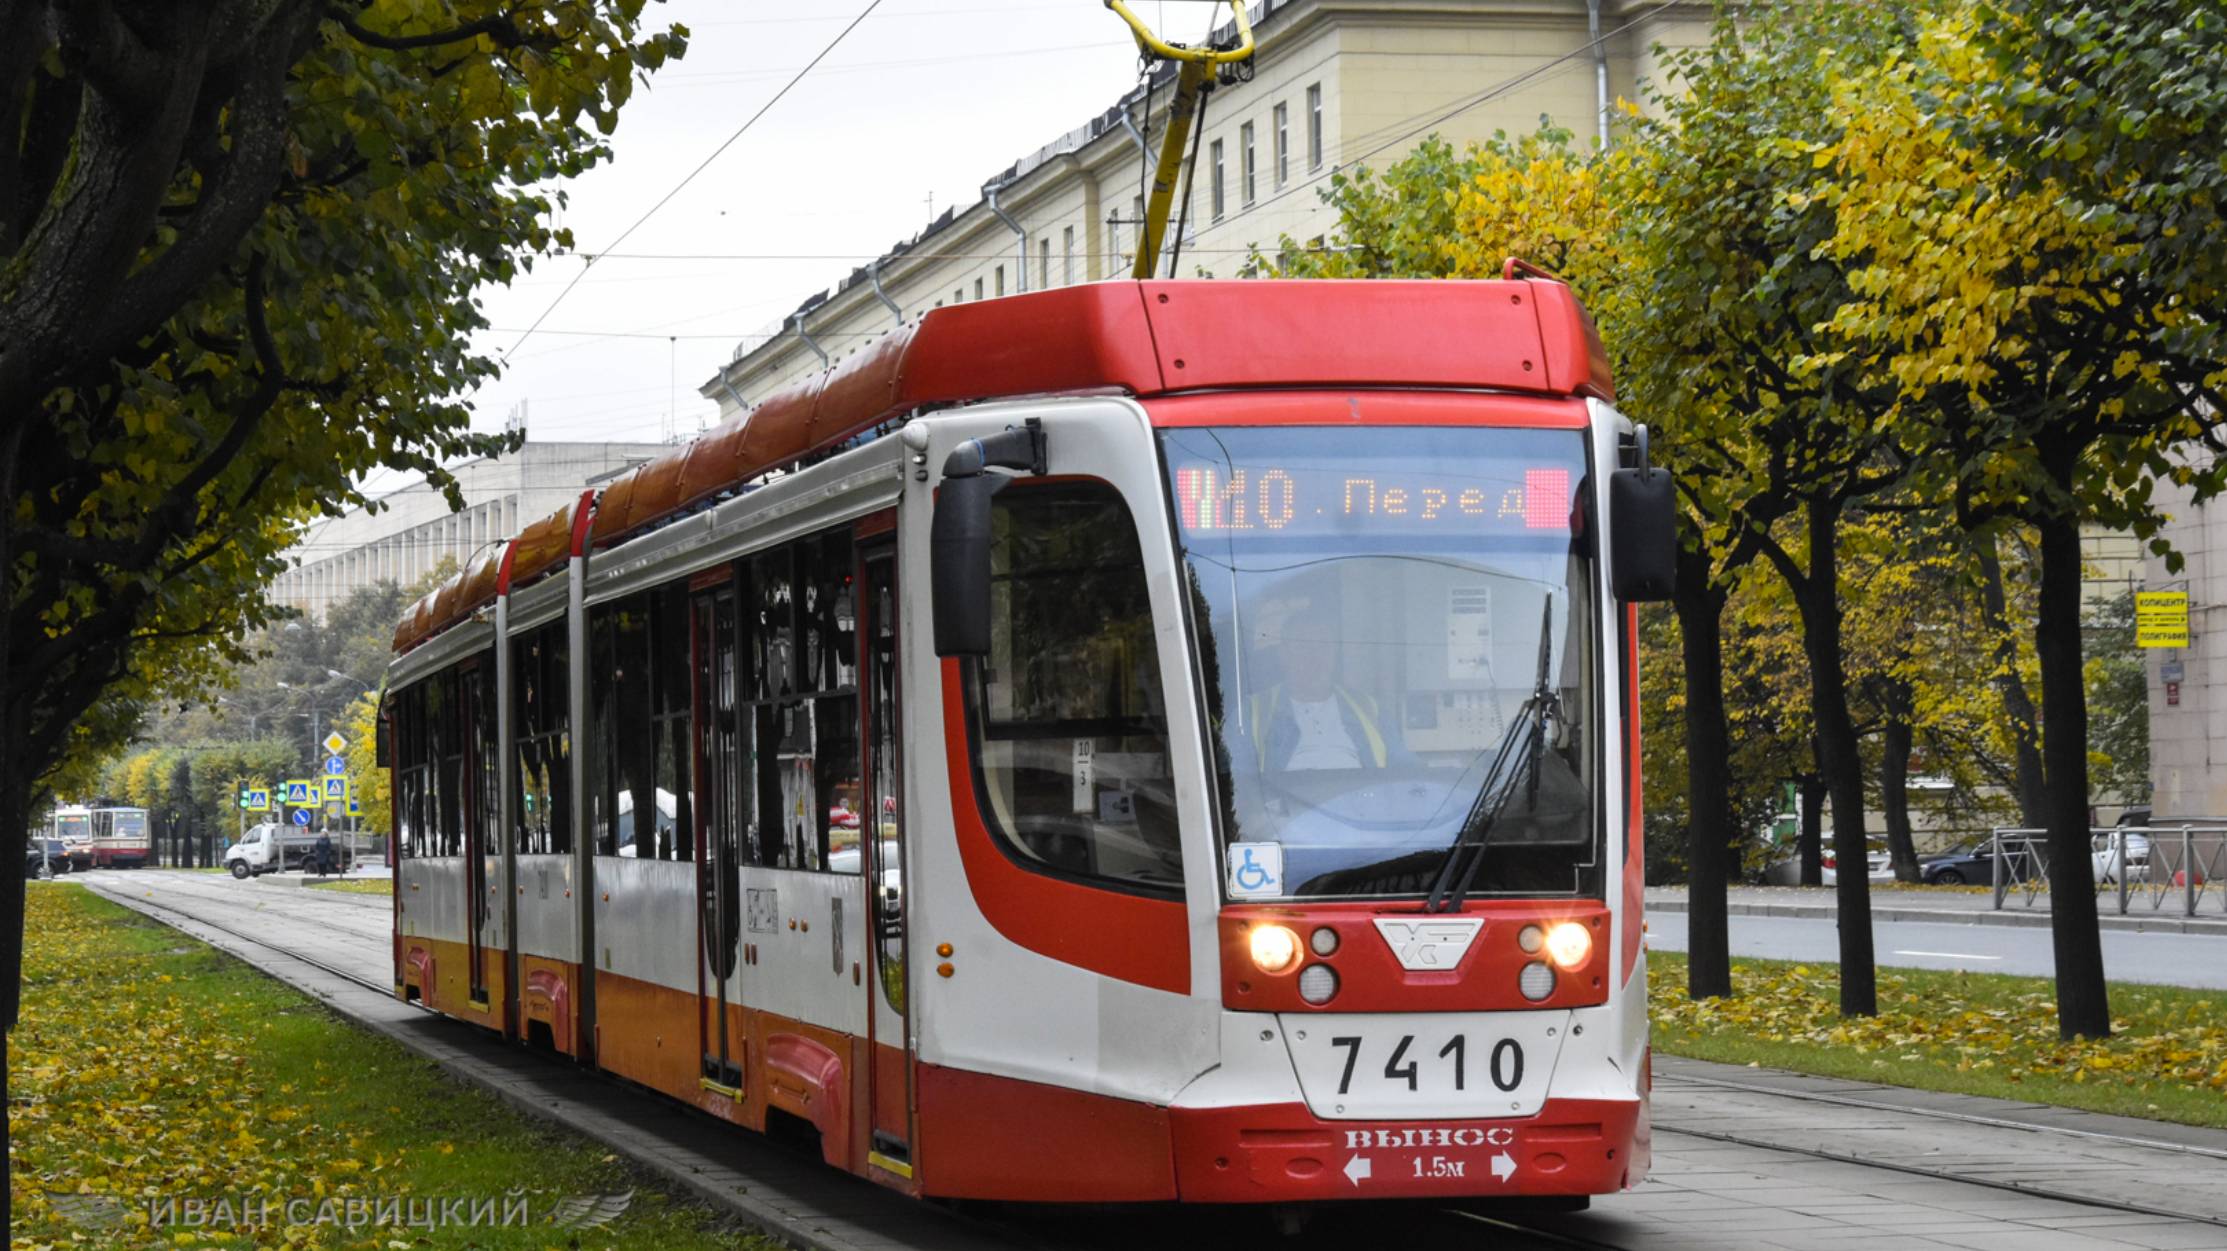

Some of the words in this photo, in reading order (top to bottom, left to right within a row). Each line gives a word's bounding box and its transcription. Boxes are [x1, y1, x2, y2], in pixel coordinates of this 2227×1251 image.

[1344, 478, 1525, 519] Перед
[1332, 1034, 1525, 1095] 7410
[1344, 1128, 1513, 1149] ВЫНОС
